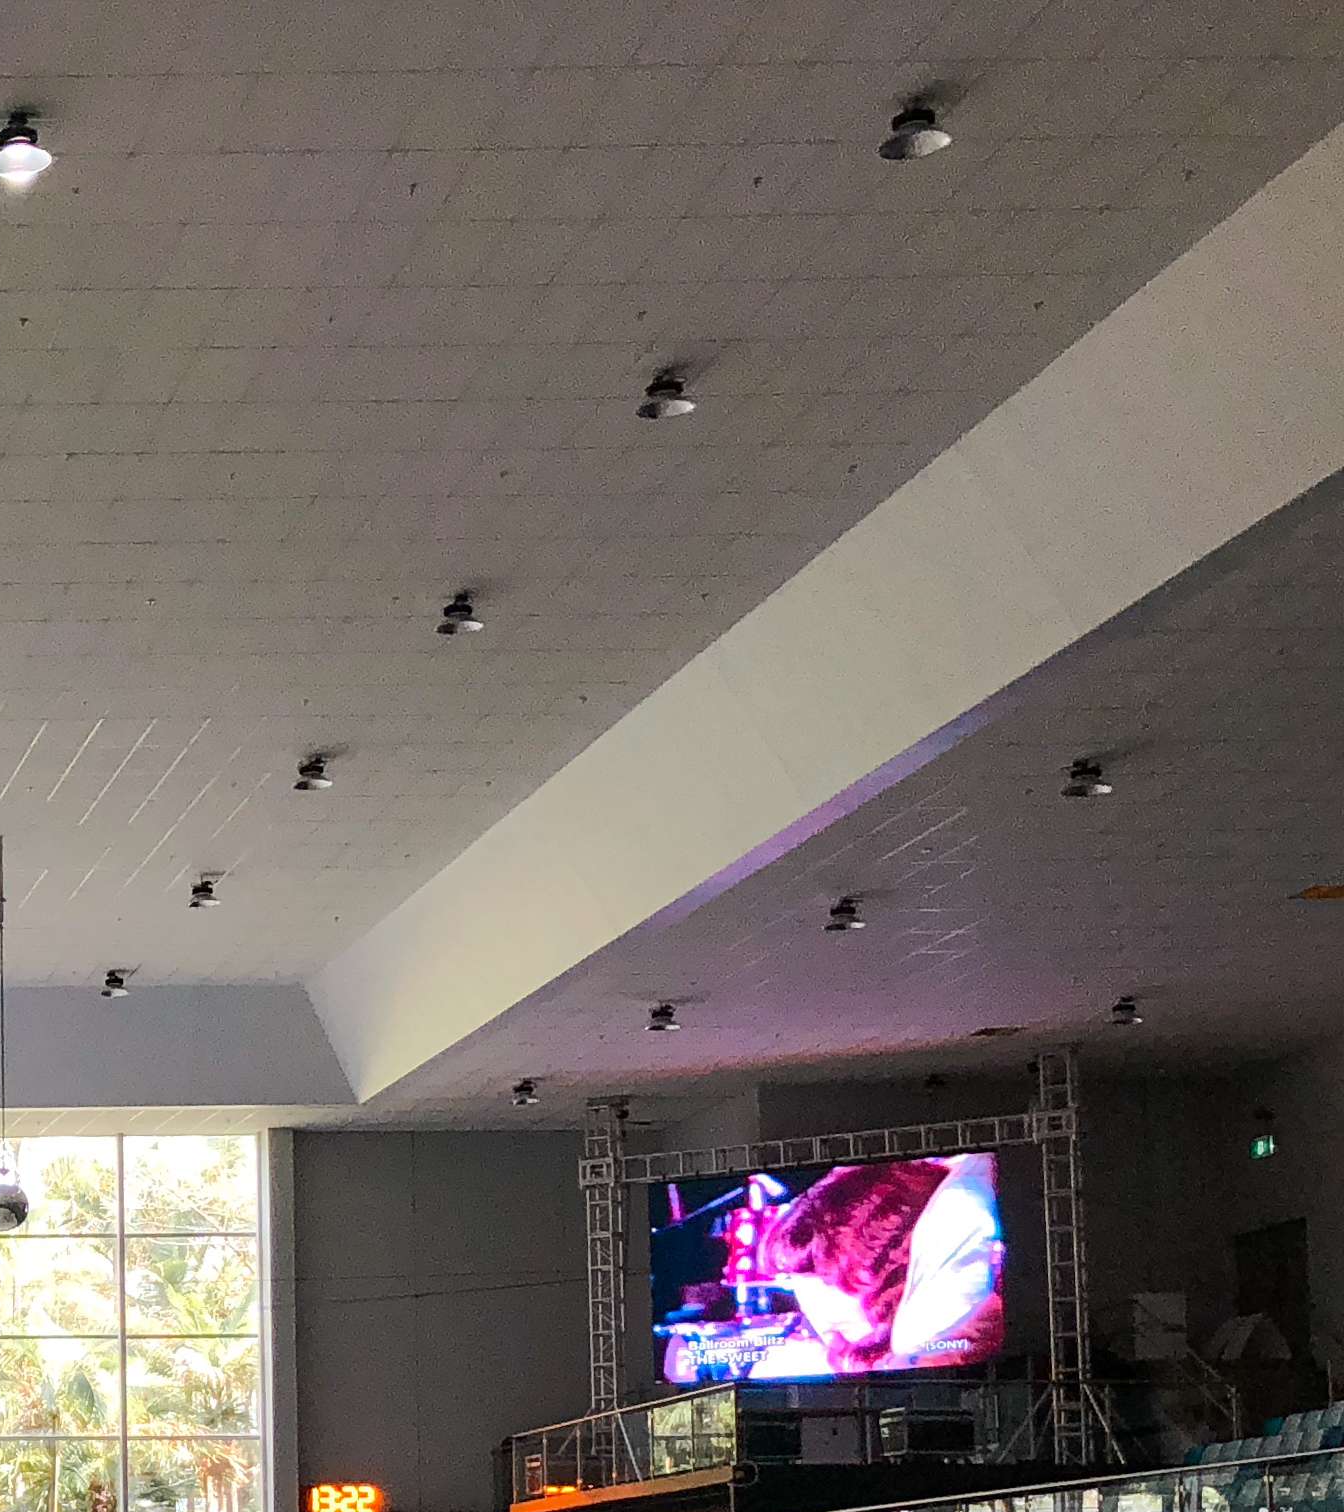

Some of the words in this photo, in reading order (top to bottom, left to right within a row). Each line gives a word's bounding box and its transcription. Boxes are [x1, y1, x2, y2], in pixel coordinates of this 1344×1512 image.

[688, 1338, 749, 1351] Ballroom
[753, 1335, 786, 1347] Blitz
[926, 1338, 968, 1351] (SONY)
[689, 1353, 716, 1366] THE
[719, 1350, 768, 1363] SWEET
